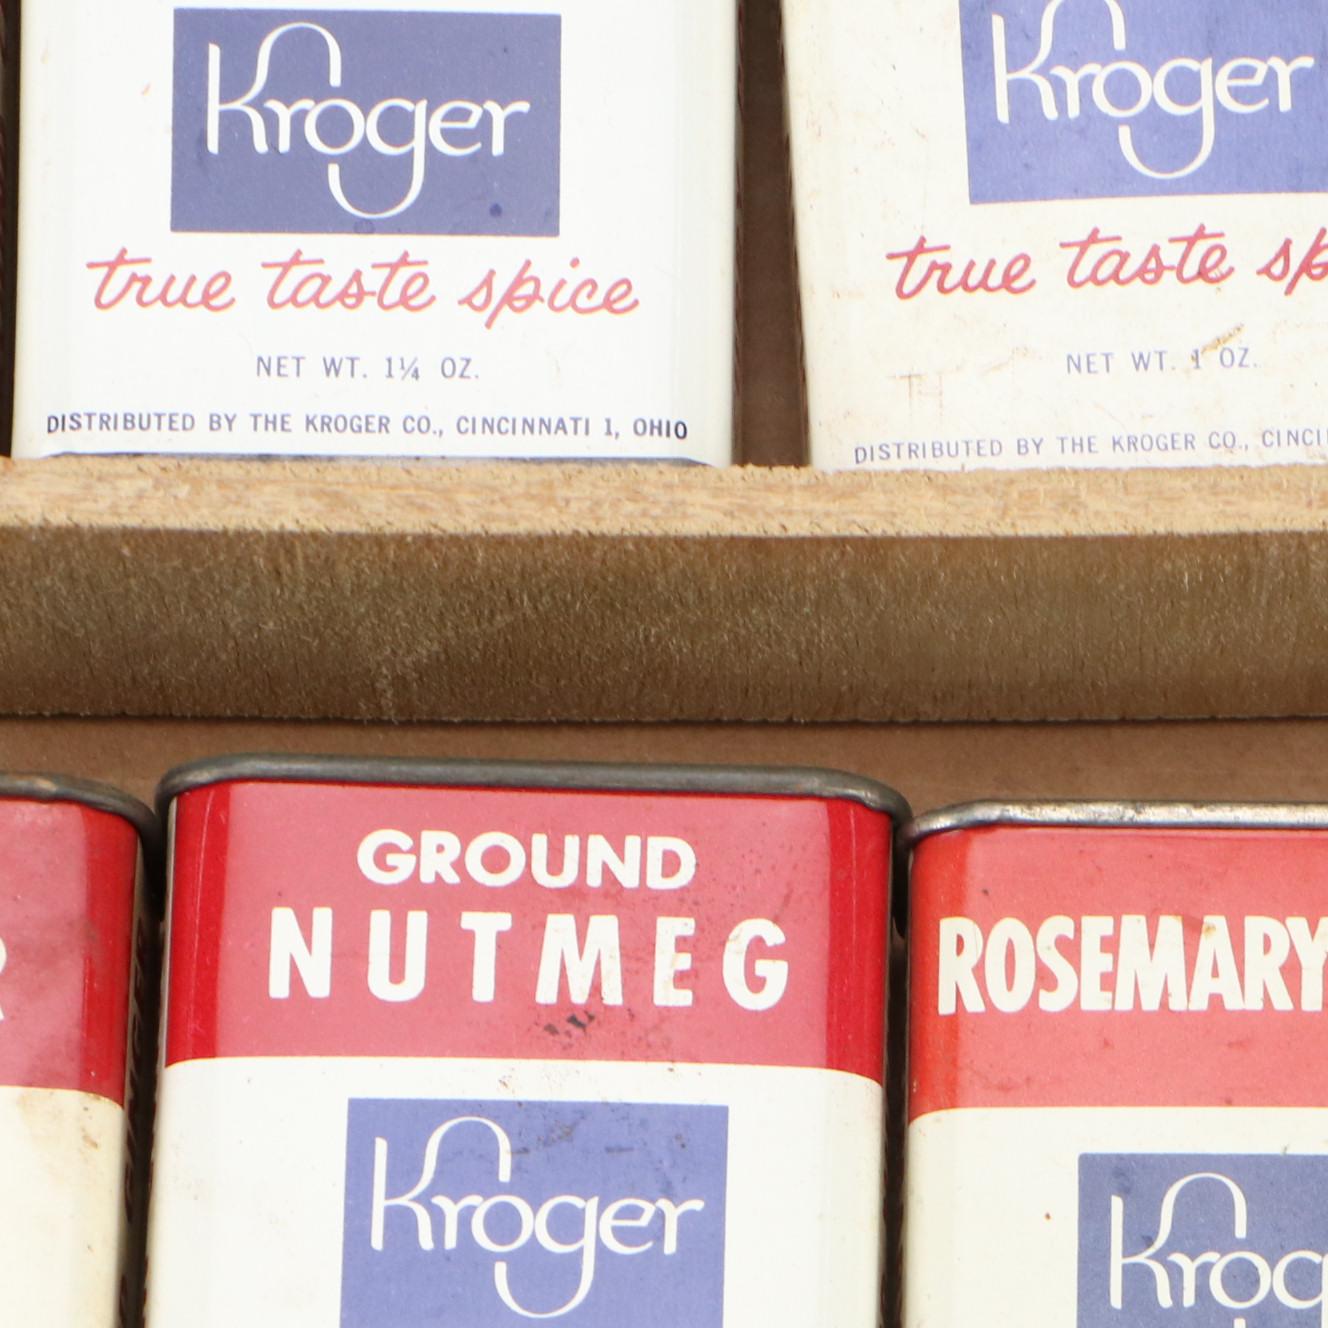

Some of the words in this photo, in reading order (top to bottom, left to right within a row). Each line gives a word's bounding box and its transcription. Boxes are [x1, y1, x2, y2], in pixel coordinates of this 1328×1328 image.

[207, 23, 530, 218] Kroger
[992, 0, 1314, 179] Kroger
[86, 248, 235, 313] true
[261, 249, 436, 313] taste
[458, 257, 640, 330] spice
[886, 236, 1036, 301] true
[1059, 224, 1234, 290] taste
[257, 356, 304, 377] NET
[323, 357, 366, 378] WT.
[441, 357, 480, 379] OZ.
[1067, 353, 1112, 374] NET
[1132, 351, 1176, 371] WT.
[1190, 346, 1200, 370] 1
[1219, 347, 1258, 368] OZ.
[47, 413, 195, 434] DISTRIBUTED
[209, 413, 236, 432] BY
[250, 414, 291, 432] THE
[306, 414, 390, 434] KROGER
[403, 415, 443, 437] CO.,
[456, 416, 589, 436] CINCINNATI
[605, 418, 619, 440] 1,
[634, 419, 687, 440] OHIO
[854, 440, 1002, 464] DISTRIBUTED
[1017, 438, 1043, 456] BY
[1055, 436, 1098, 454] THE
[1112, 433, 1195, 453] KROGER
[1208, 431, 1248, 455] CO.,
[357, 830, 696, 889] GROUND
[269, 908, 788, 1010] NUTMEG
[371, 1117, 704, 1318] Kroger
